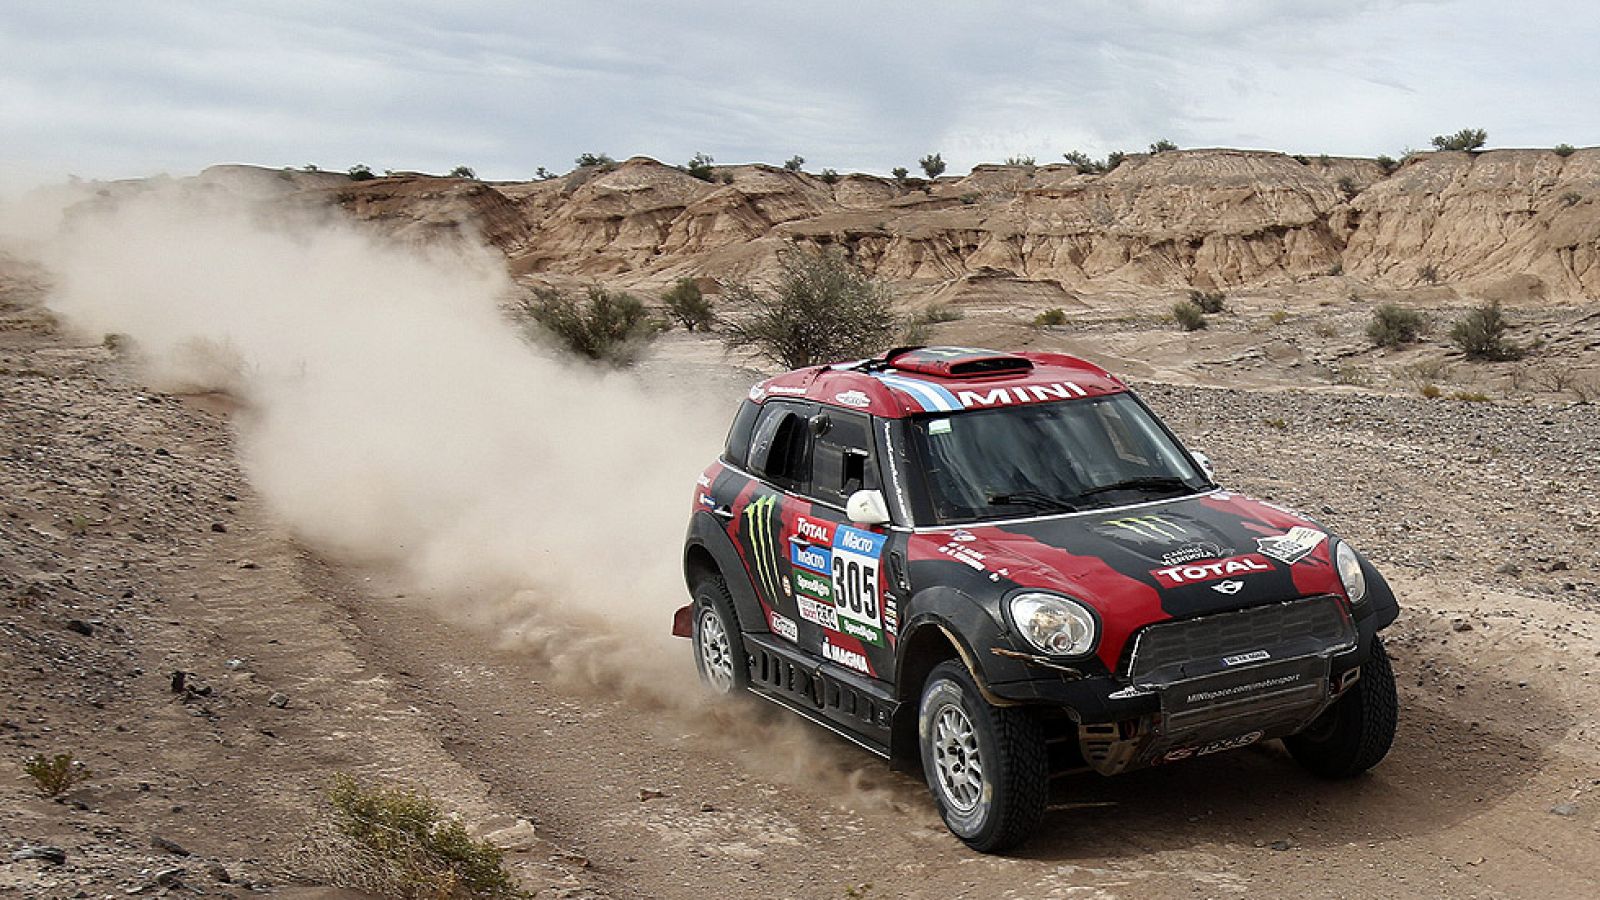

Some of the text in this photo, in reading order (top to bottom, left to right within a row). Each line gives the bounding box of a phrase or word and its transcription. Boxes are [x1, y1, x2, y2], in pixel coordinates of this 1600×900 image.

[958, 381, 1088, 408] MINI
[797, 517, 829, 542] TOTAL
[842, 530, 873, 552] Macro
[1157, 557, 1269, 583] TOTAL
[833, 556, 876, 620] 305
[1186, 673, 1300, 704] MINIspace.com/motorsport
